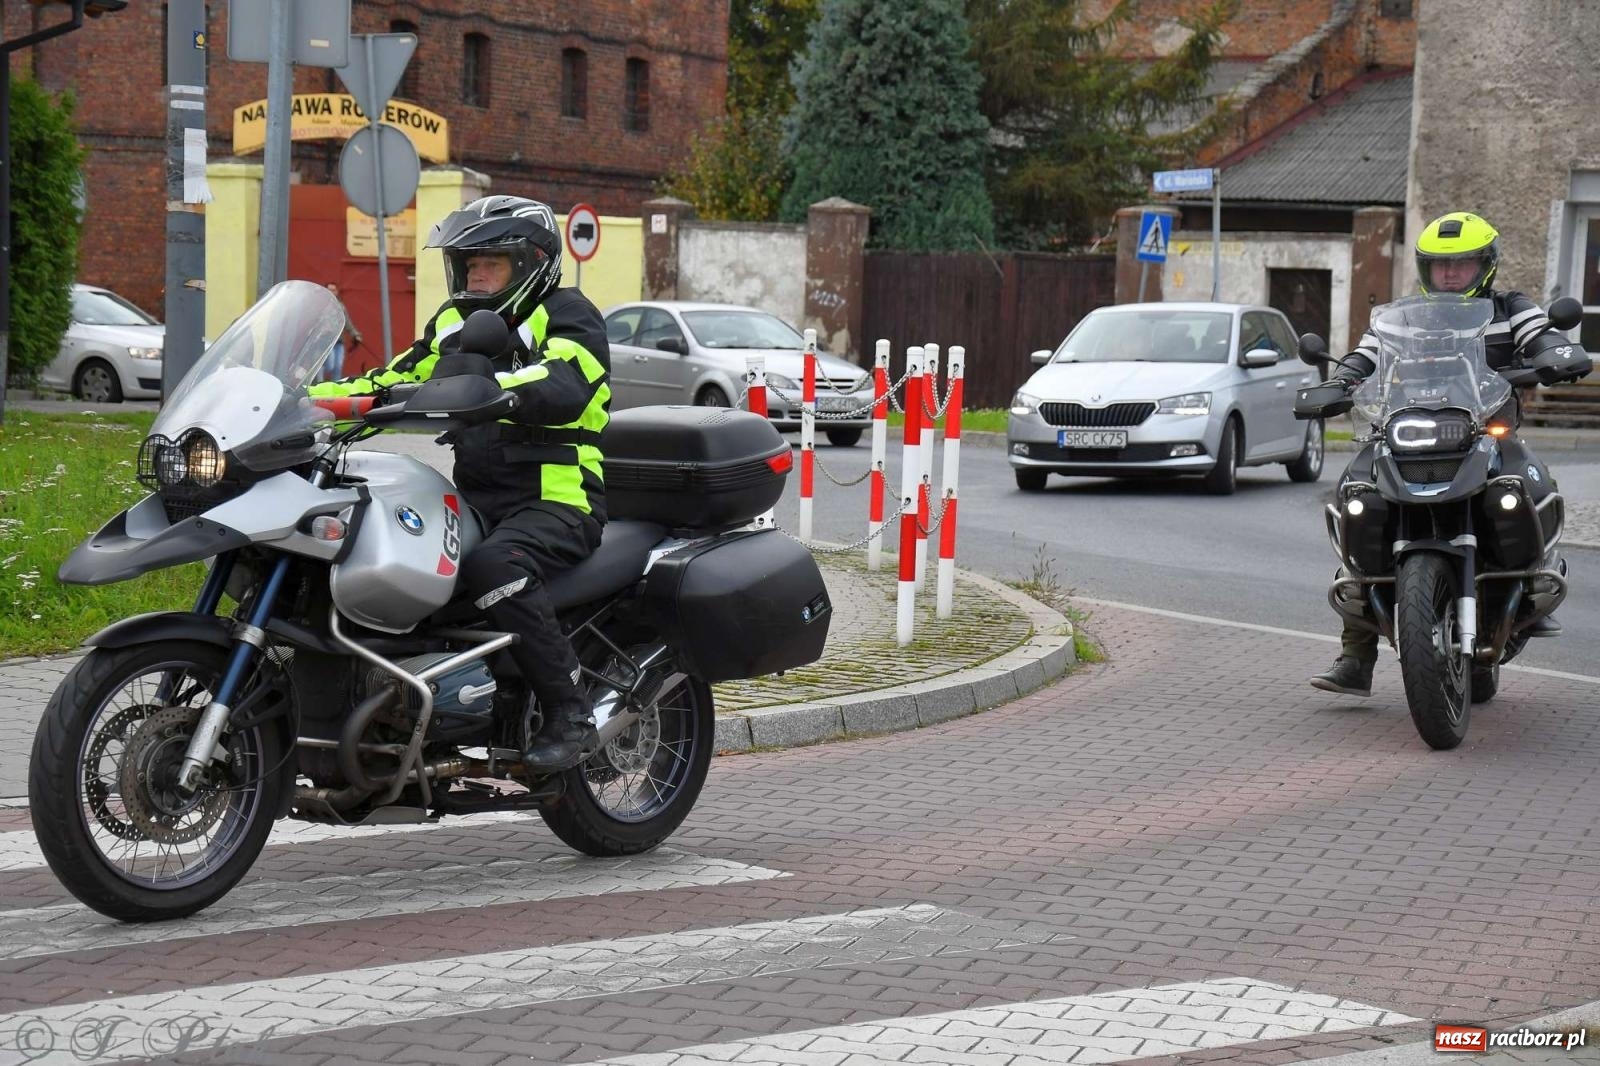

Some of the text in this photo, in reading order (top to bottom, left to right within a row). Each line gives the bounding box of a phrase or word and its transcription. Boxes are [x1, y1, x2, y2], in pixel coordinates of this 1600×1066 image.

[242, 97, 440, 134] NAAWA ROERÓW
[1066, 432, 1123, 445] SRC CK75
[443, 506, 460, 561] GS
